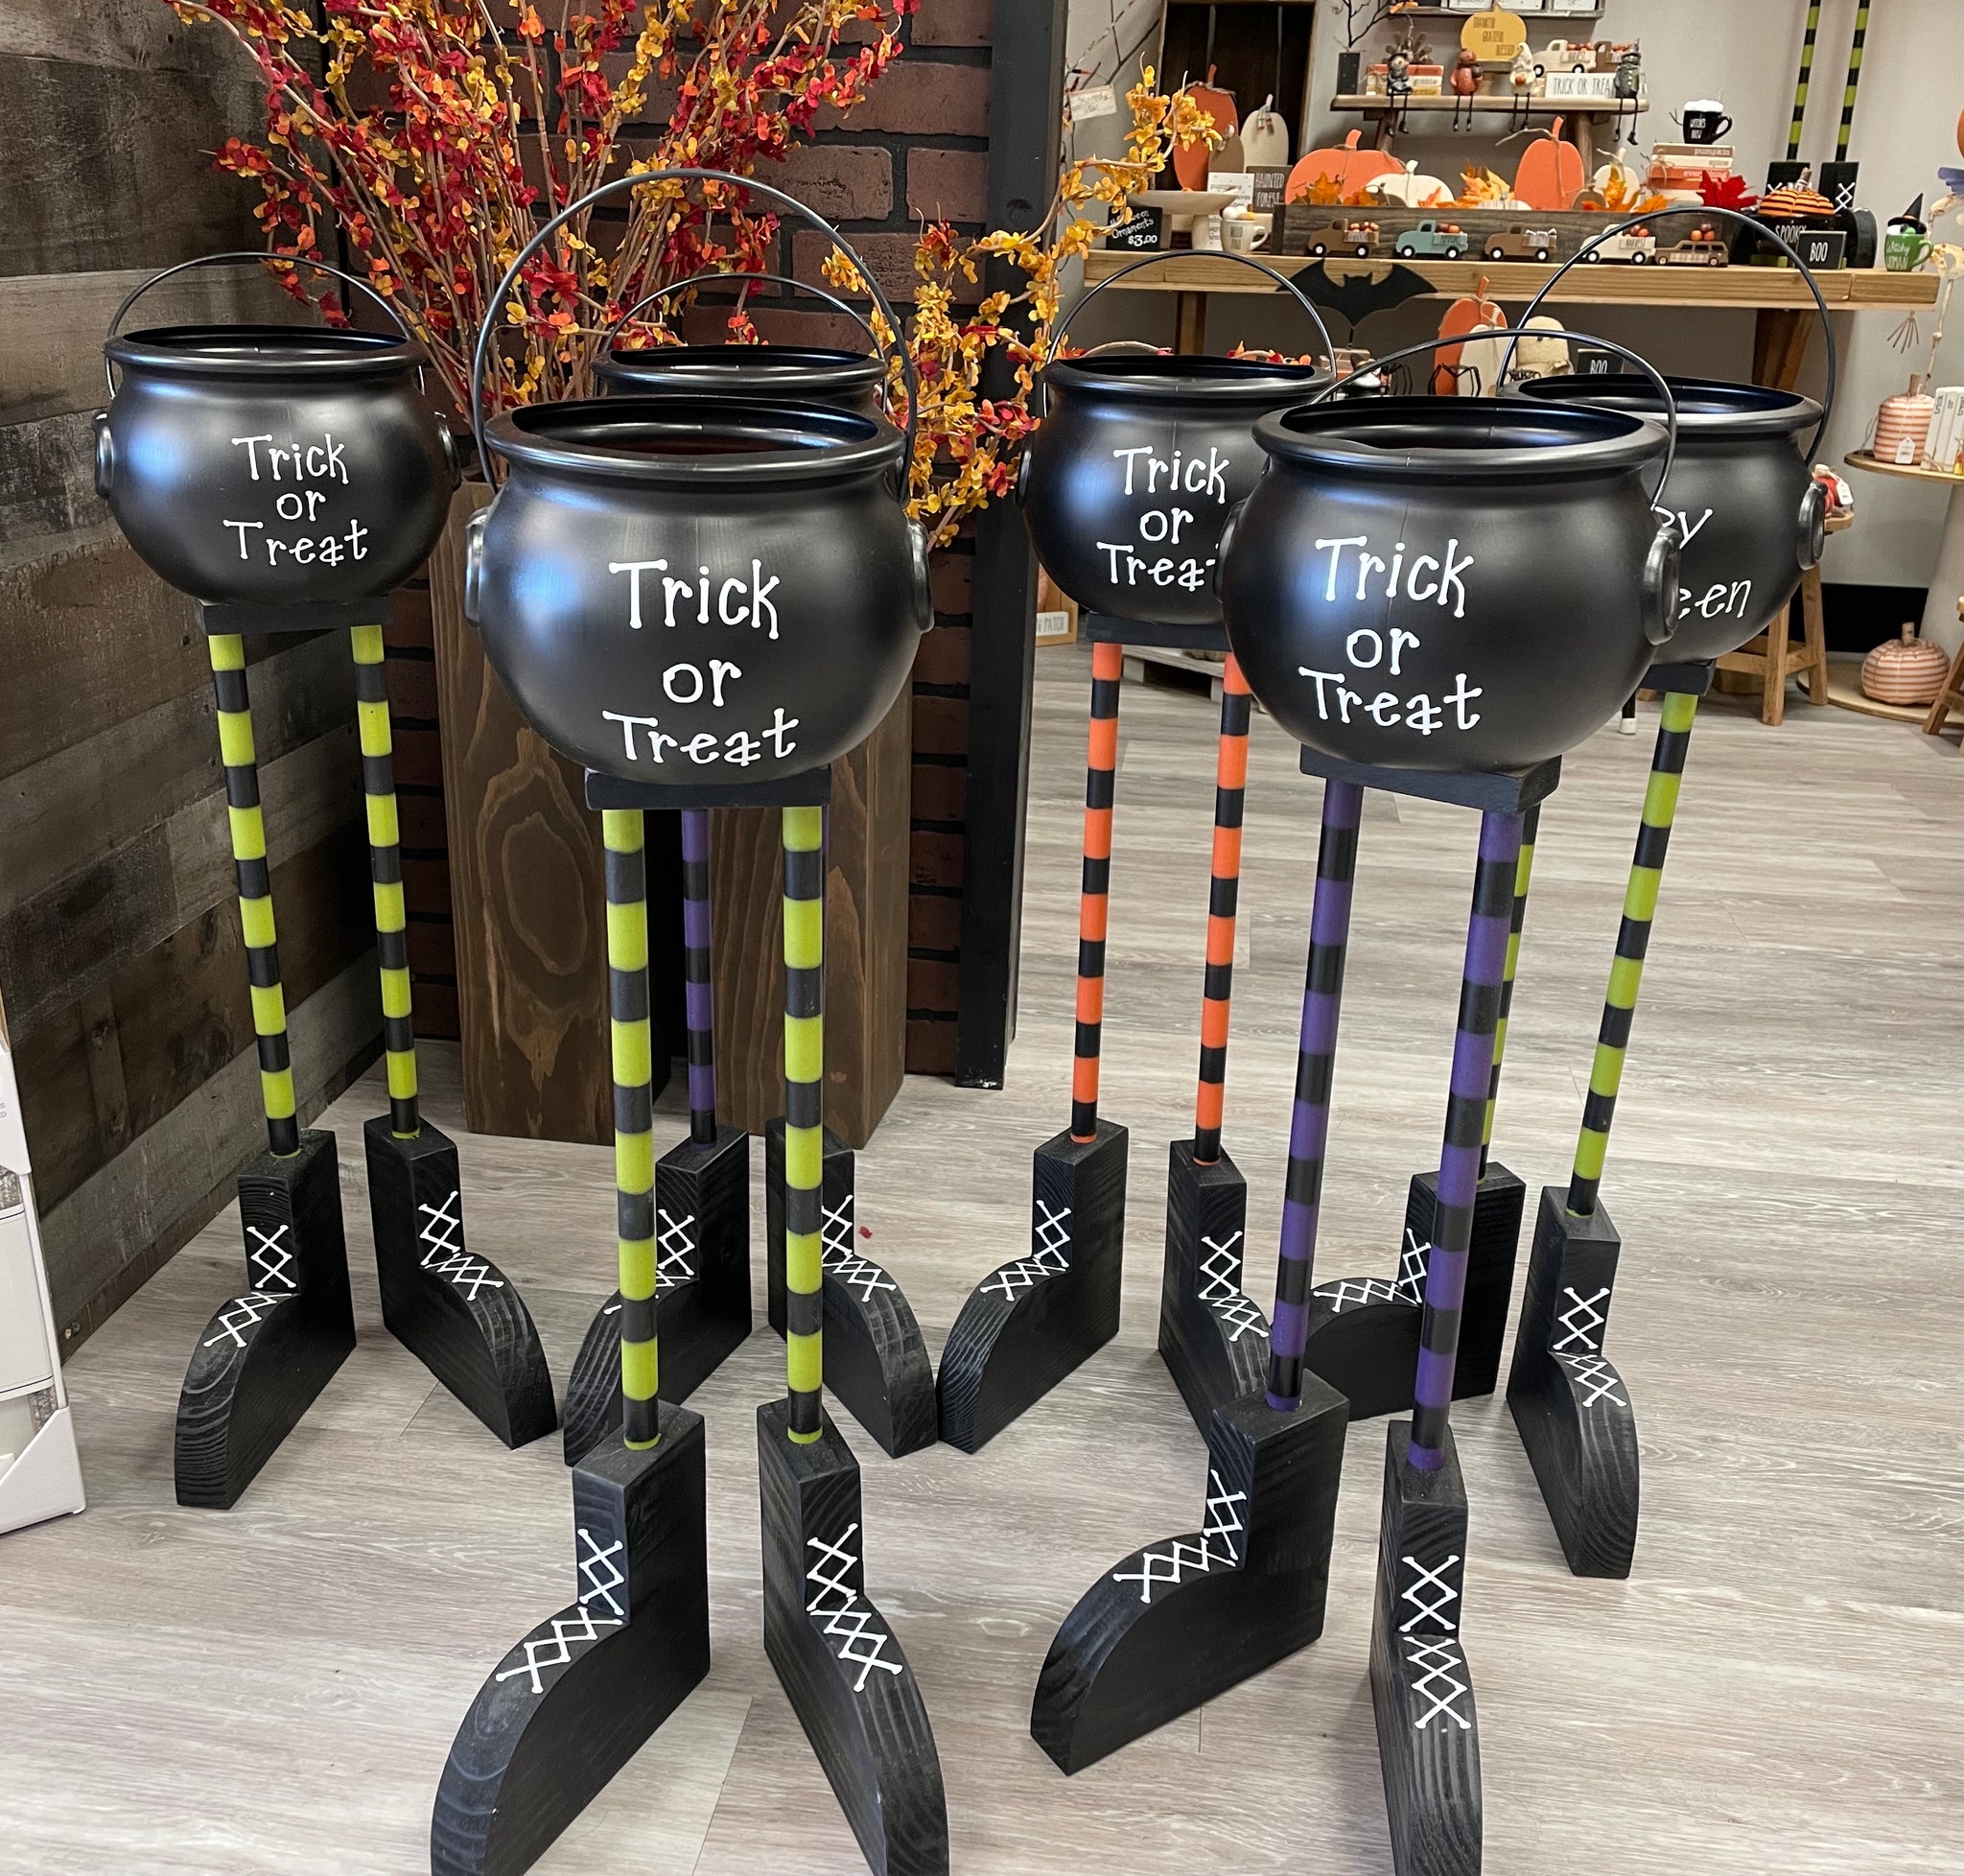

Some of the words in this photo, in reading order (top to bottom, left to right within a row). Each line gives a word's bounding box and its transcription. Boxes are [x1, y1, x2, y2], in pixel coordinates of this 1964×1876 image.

[1554, 78, 1574, 95] TRICK
[1578, 78, 1588, 95] OR
[1694, 148, 1731, 156] pumpkin
[1112, 218, 1155, 239] Ornaments
[1128, 234, 1158, 246] $3.00
[1810, 242, 1828, 262] BOO
[1589, 359, 1608, 374] BOO
[231, 433, 349, 485] Trick
[1112, 445, 1230, 504] Trick
[276, 490, 327, 521] or
[1139, 507, 1194, 545] or
[222, 519, 368, 567] Treat
[1096, 541, 1219, 592] Trea
[607, 558, 782, 641] Trick
[1314, 534, 1476, 620] Trick
[1345, 627, 1421, 677] or
[662, 658, 743, 708] or
[1298, 665, 1484, 737] Treat
[601, 707, 801, 767] Treat
